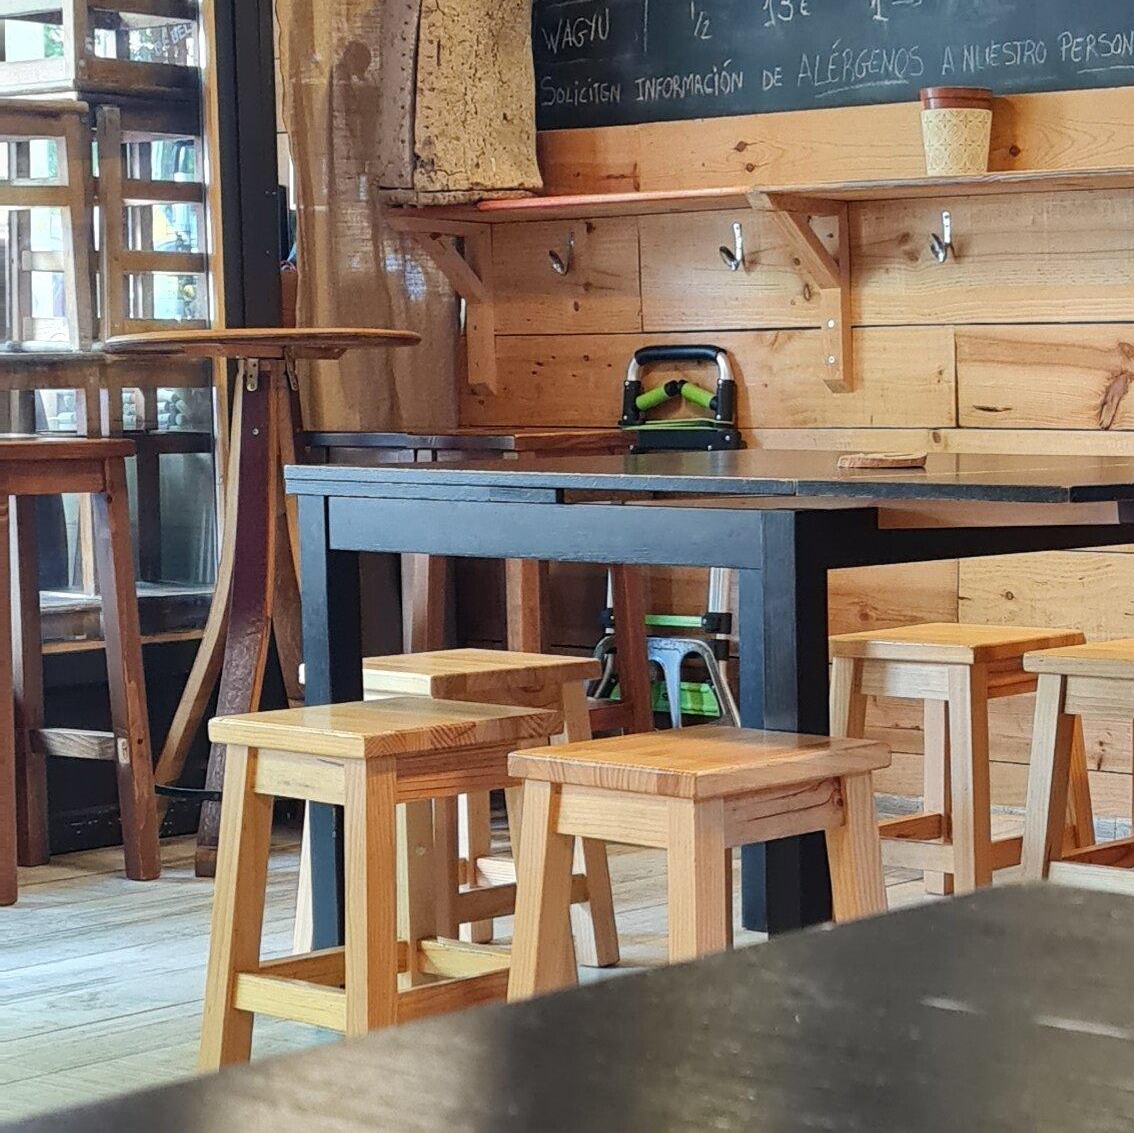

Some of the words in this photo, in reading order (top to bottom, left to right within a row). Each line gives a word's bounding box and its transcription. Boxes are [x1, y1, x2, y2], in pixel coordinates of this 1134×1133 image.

[539, 75, 621, 107] SOLICITEN
[635, 58, 744, 103] INFORMACIÓN
[762, 66, 784, 92] DE
[940, 45, 956, 77] A
[962, 39, 1048, 76] NUESTRO
